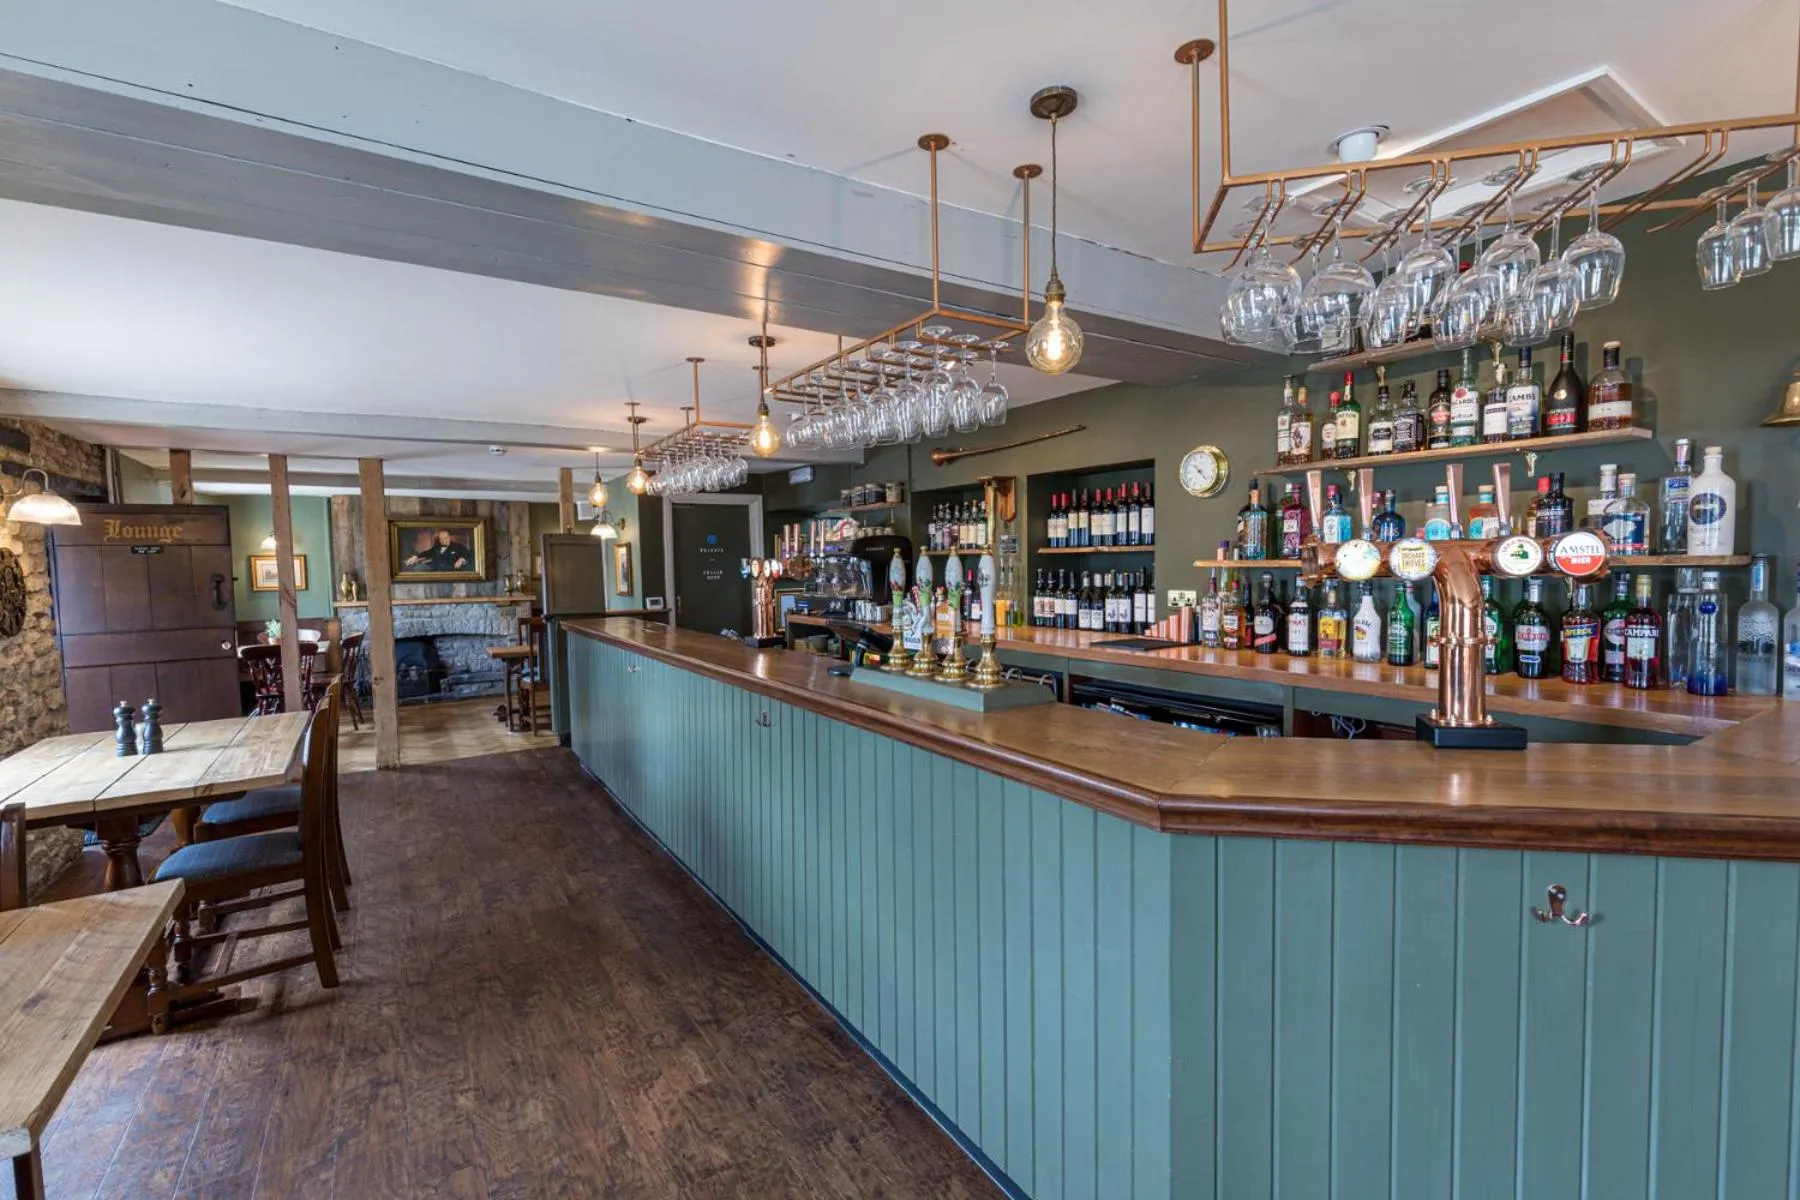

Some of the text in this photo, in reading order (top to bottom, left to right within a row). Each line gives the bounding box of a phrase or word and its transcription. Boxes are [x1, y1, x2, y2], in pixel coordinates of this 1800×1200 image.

[103, 519, 184, 543] Lounge
[1560, 545, 1600, 554] AMSTEL
[1571, 557, 1591, 565] BIER
[1624, 628, 1659, 637] CAMPARI
